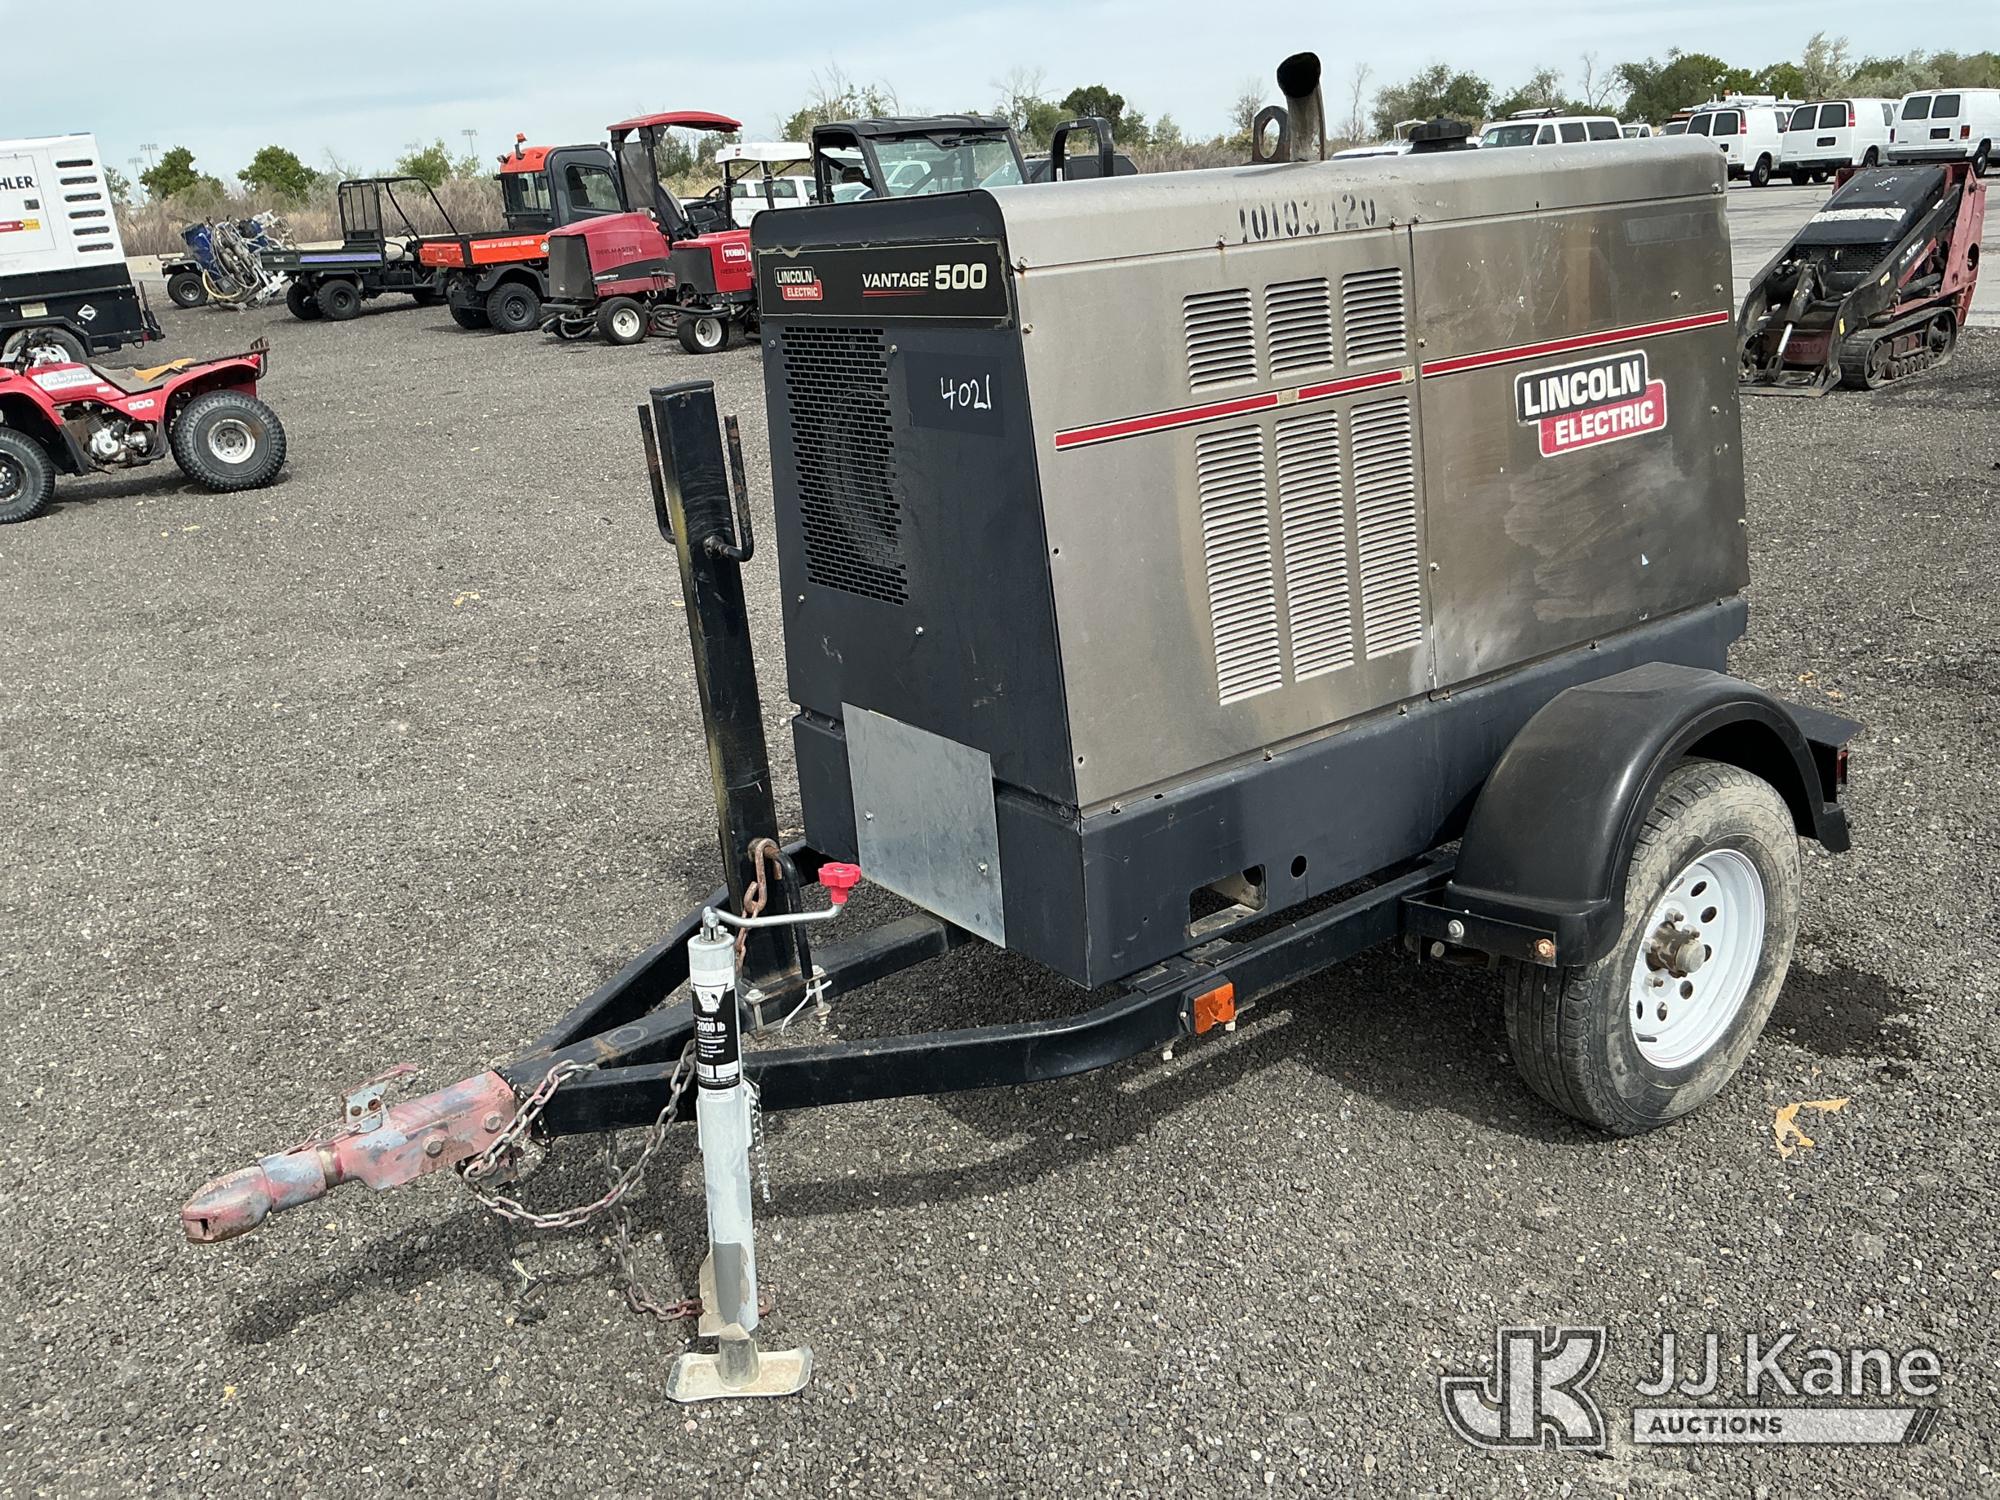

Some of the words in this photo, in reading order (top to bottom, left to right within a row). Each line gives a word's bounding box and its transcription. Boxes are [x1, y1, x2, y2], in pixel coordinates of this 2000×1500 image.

[724, 249, 745, 257] TORO
[776, 269, 813, 284] LINCOLN
[862, 272, 929, 289] VANTAGE
[934, 263, 987, 290] 500
[786, 286, 819, 298] ELECTRIC
[941, 374, 991, 410] 4021
[1523, 361, 1640, 416] LINCOLN
[1555, 400, 1654, 446] ELECTRIC
[697, 1021, 716, 1033] 2000
[717, 1022, 726, 1033] lb
